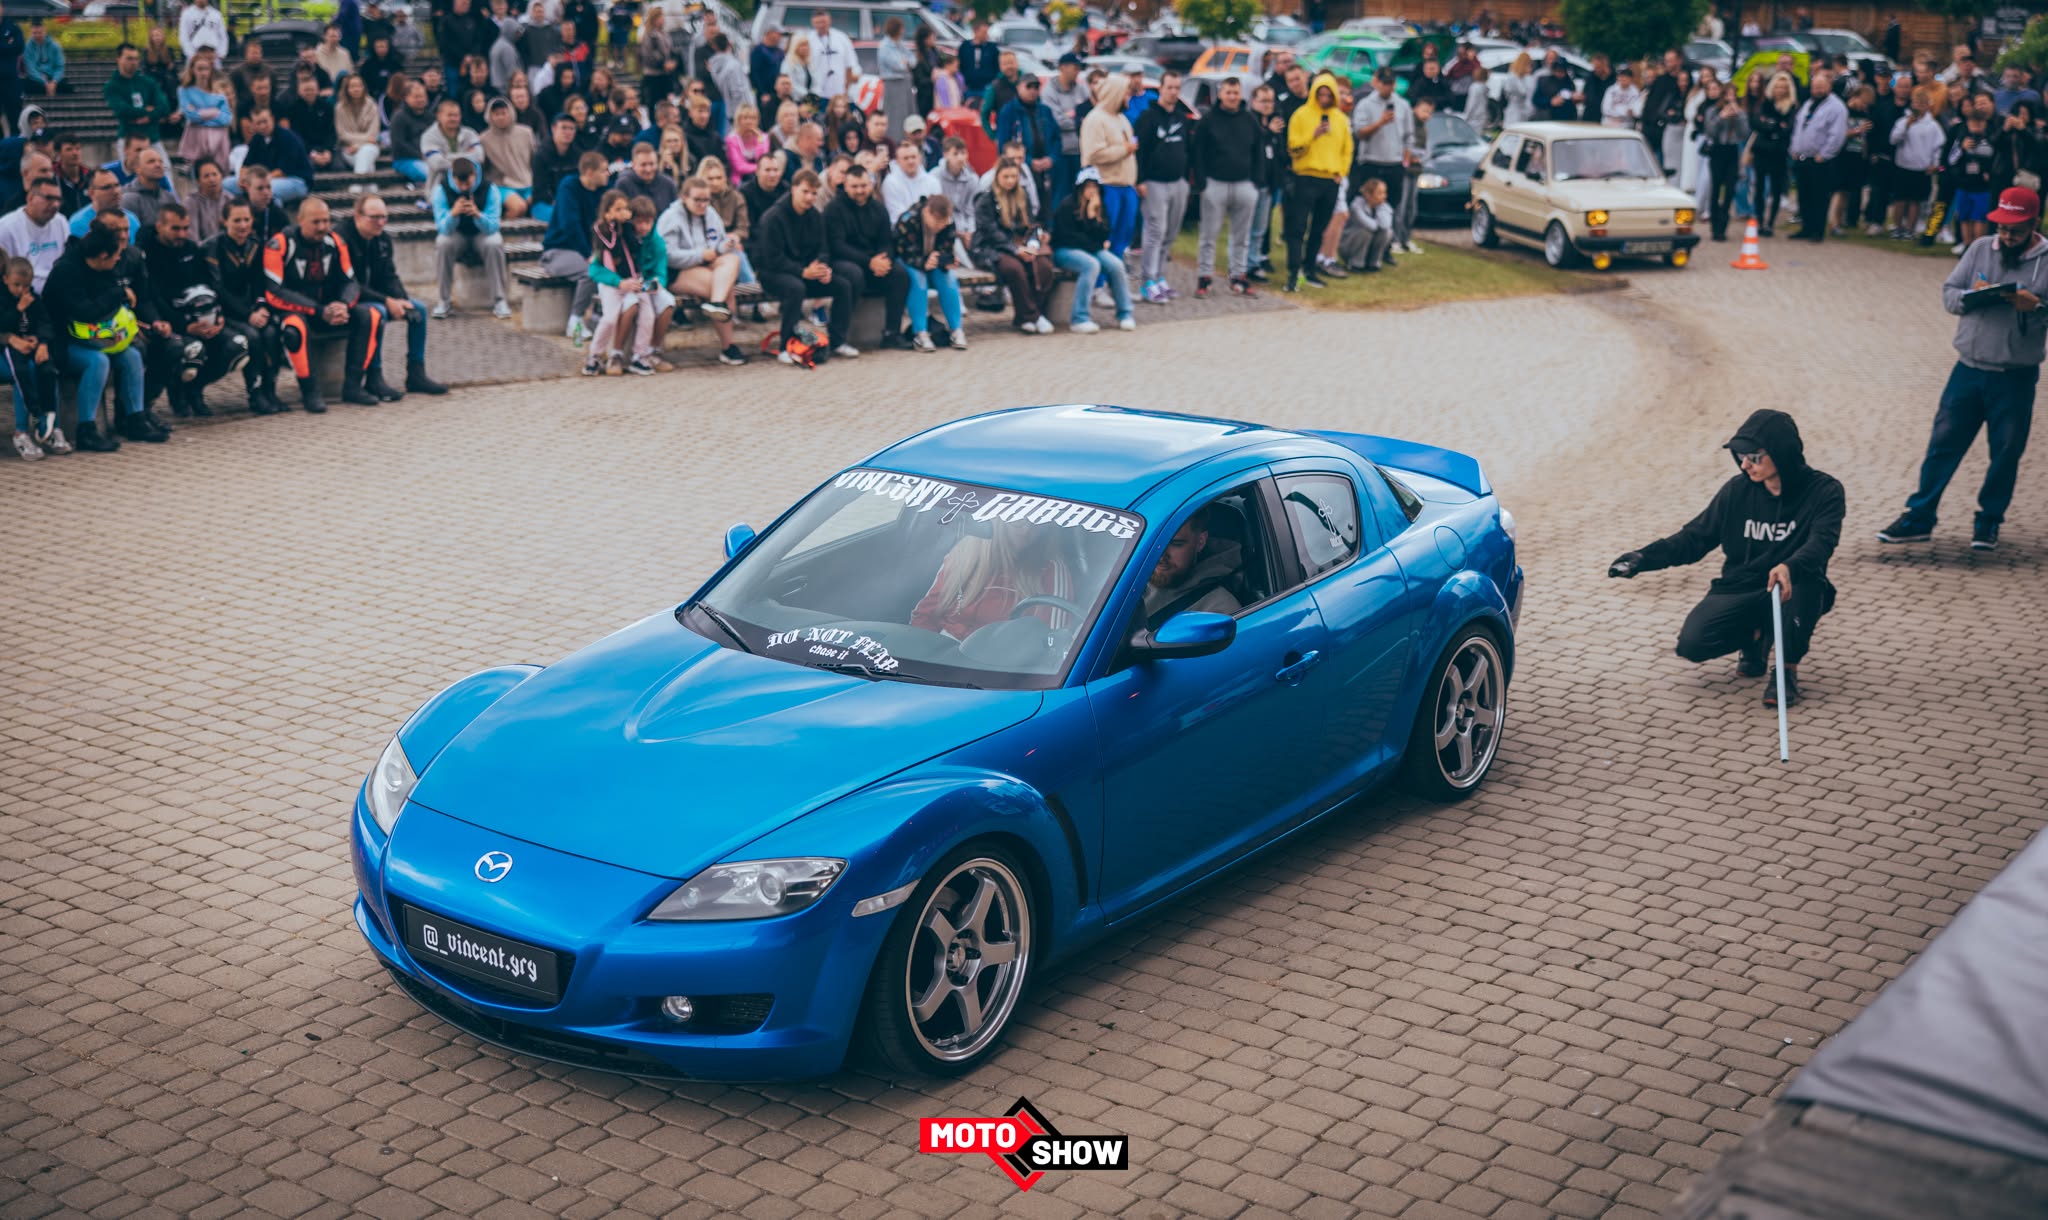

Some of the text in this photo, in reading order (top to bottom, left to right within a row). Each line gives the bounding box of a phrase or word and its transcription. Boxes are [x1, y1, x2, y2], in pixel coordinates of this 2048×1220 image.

[833, 471, 1142, 539] VINCENT GARAGE
[1743, 519, 1797, 541] NASA
[767, 627, 899, 672] DO NOT FEAR
[808, 644, 849, 660] chase it
[423, 924, 538, 983] @_vincent.grg
